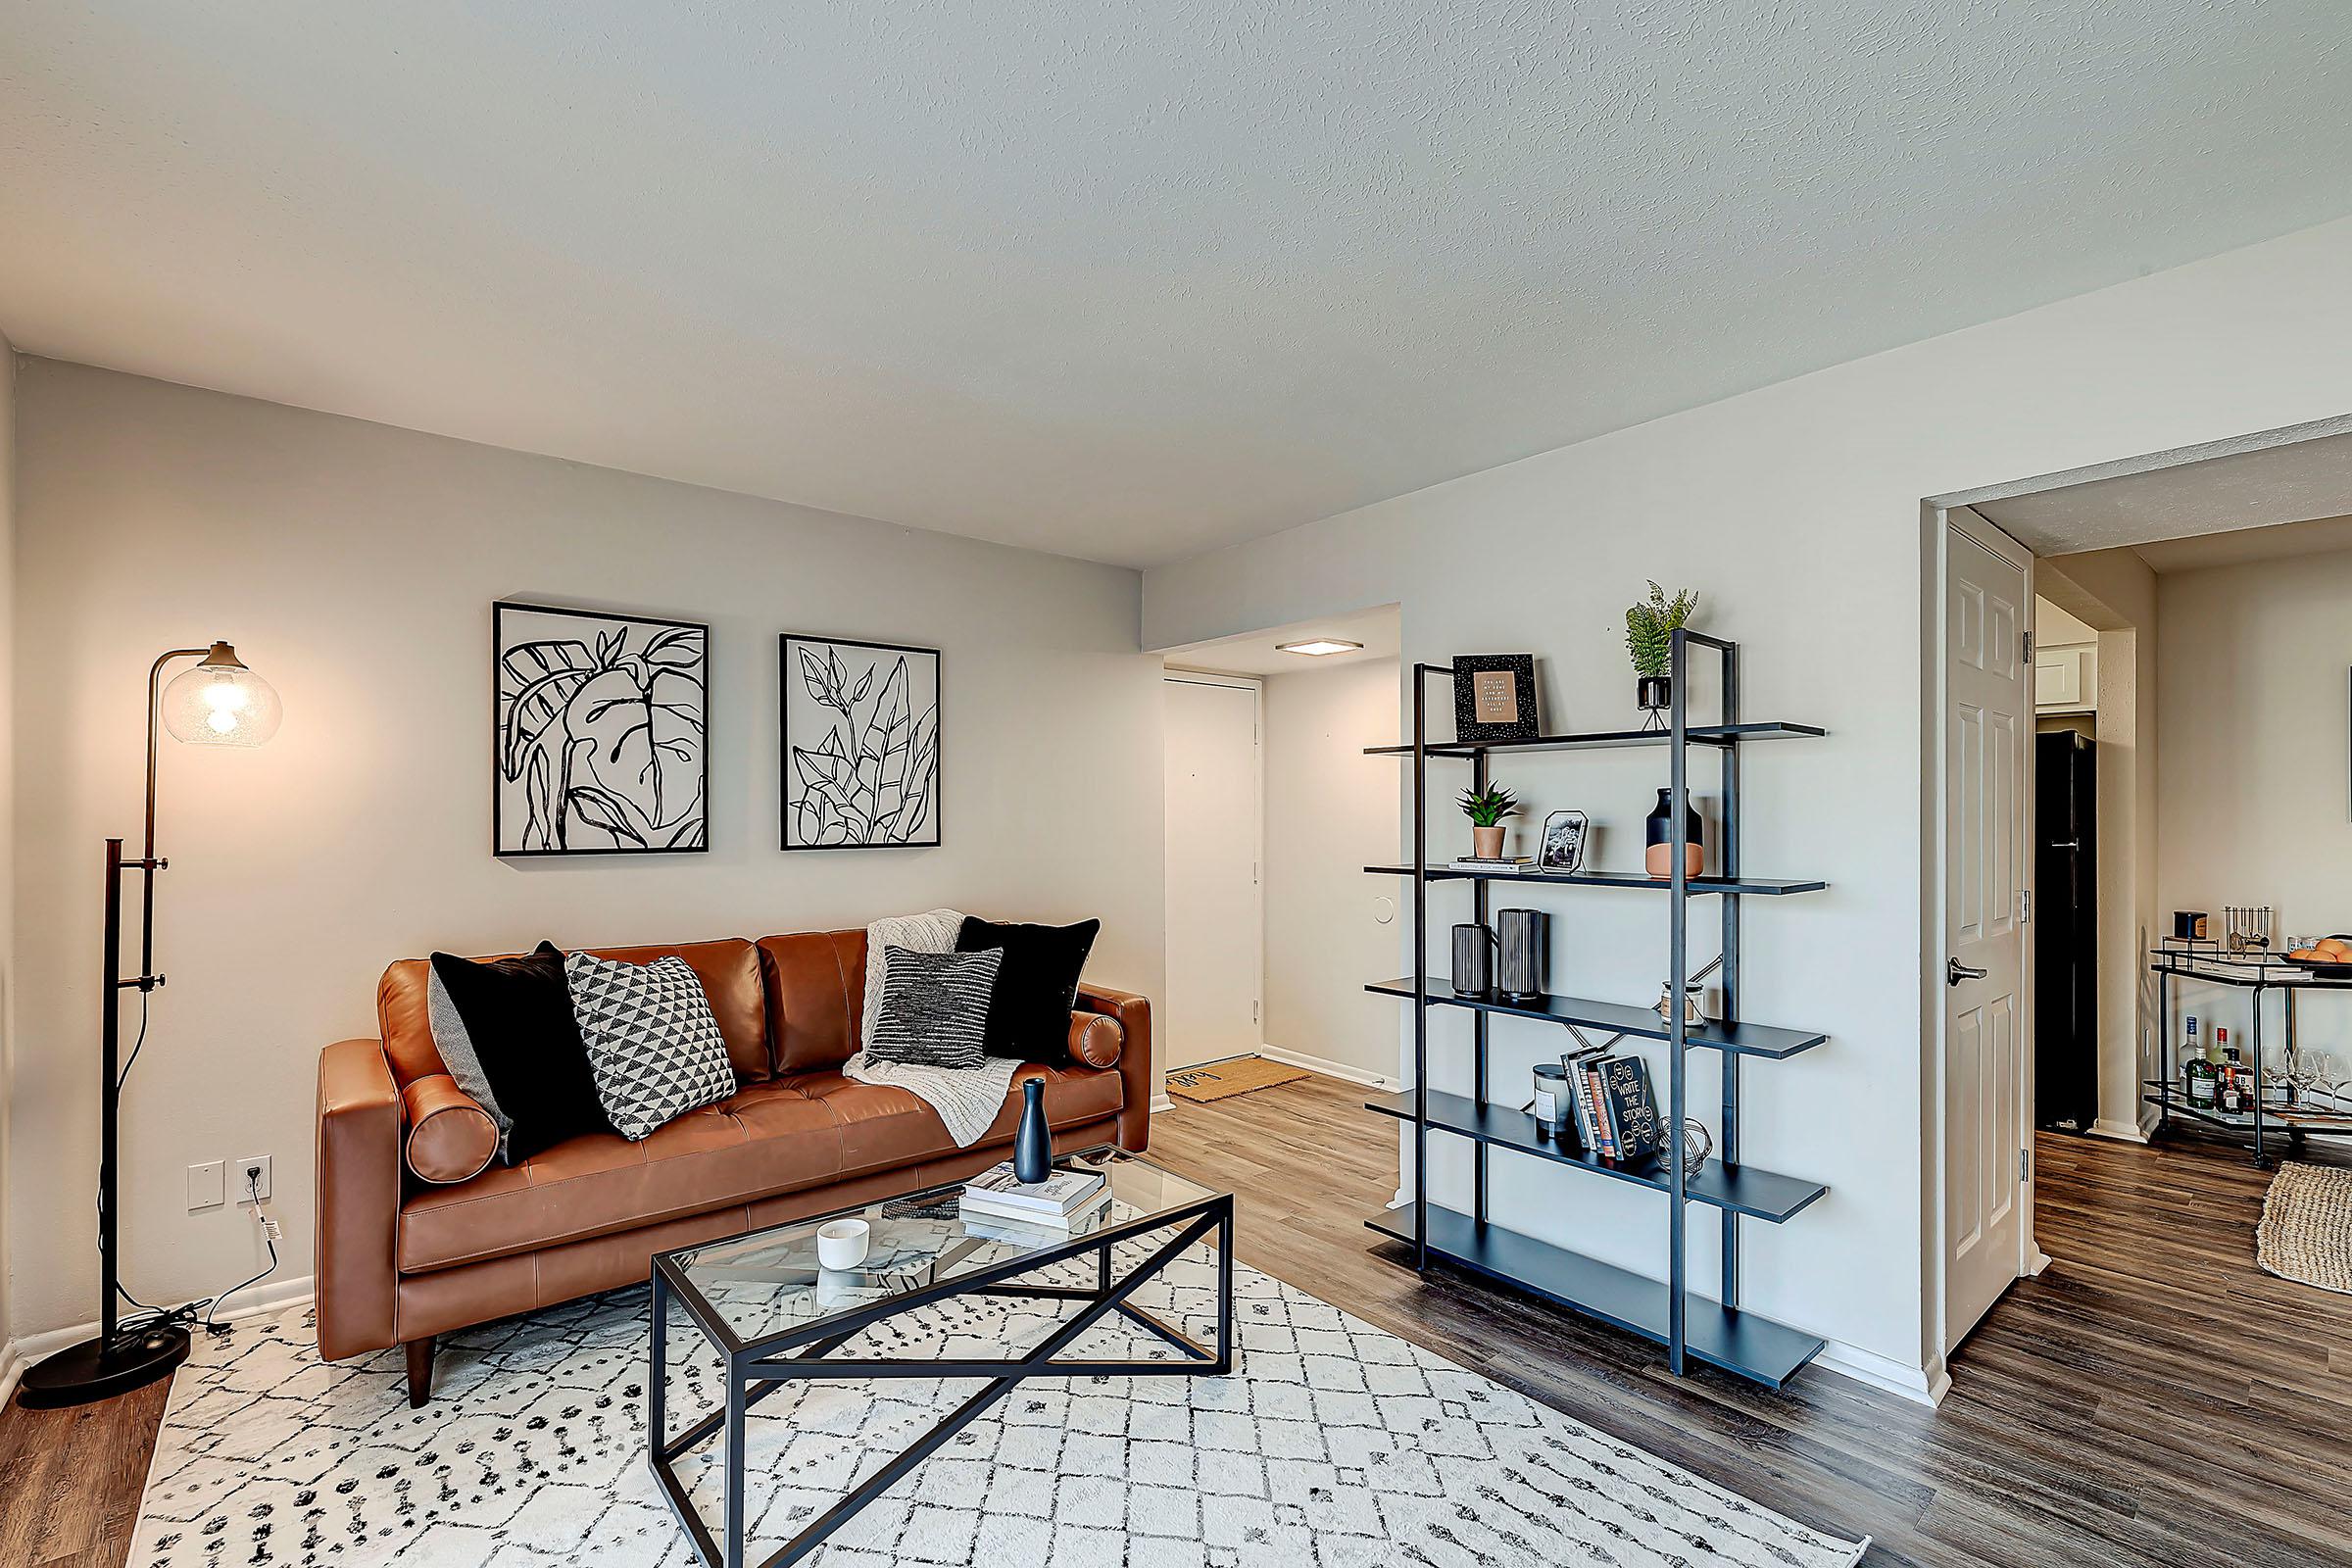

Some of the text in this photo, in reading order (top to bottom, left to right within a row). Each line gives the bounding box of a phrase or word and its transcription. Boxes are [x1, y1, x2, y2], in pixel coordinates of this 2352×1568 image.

[1579, 1067, 1590, 1085] JOHN
[1583, 1085, 1591, 1095] LE
[1617, 1080, 1641, 1096] WRITE
[1624, 1095, 1640, 1107] THE
[1623, 1107, 1644, 1122] STORY
